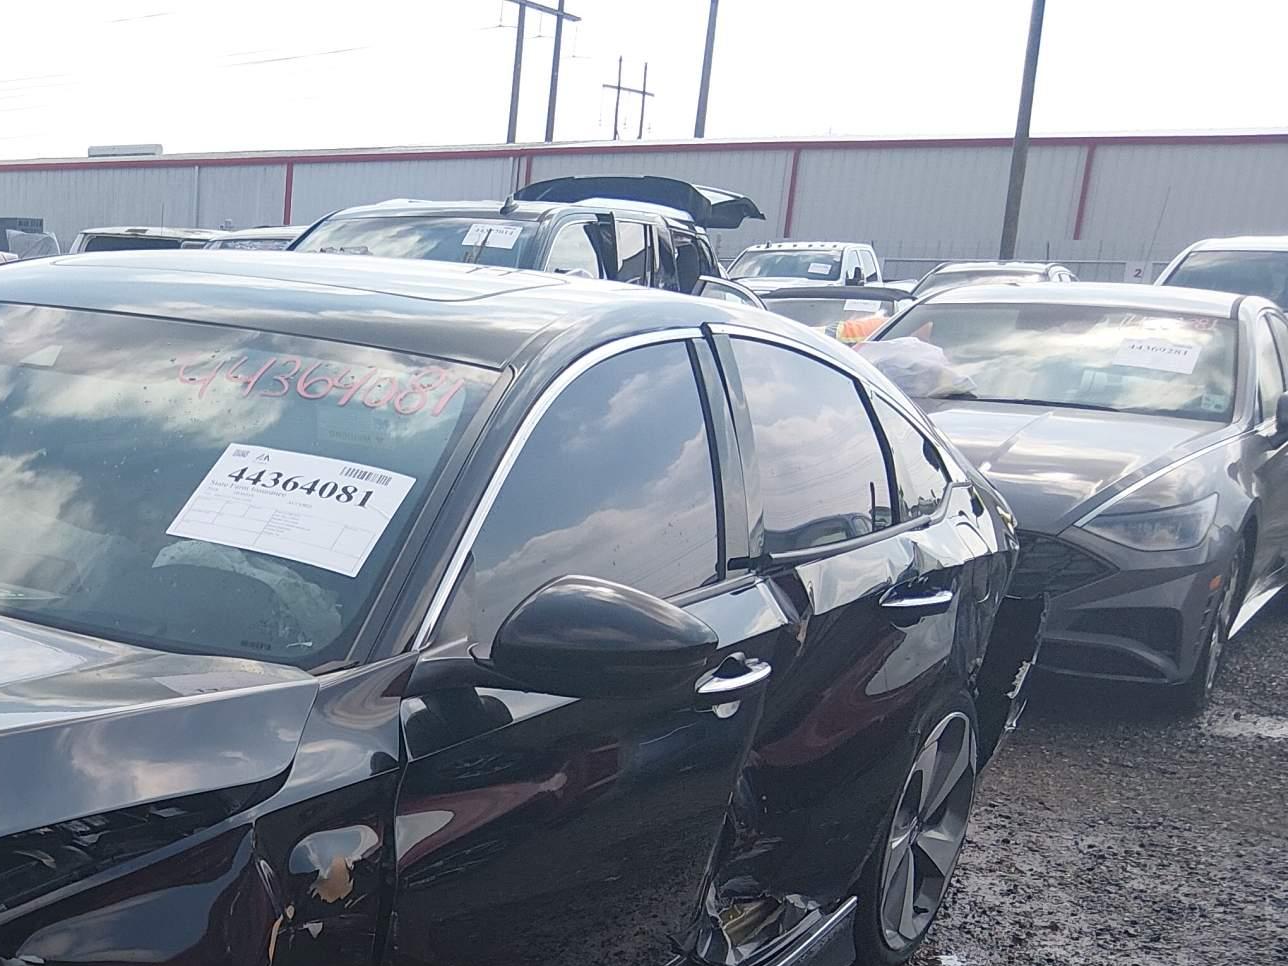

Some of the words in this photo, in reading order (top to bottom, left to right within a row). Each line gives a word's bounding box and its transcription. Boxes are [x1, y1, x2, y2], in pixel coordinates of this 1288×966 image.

[1134, 269, 1142, 279] 2
[178, 355, 465, 416] 44364081
[227, 466, 374, 509] 44364081
